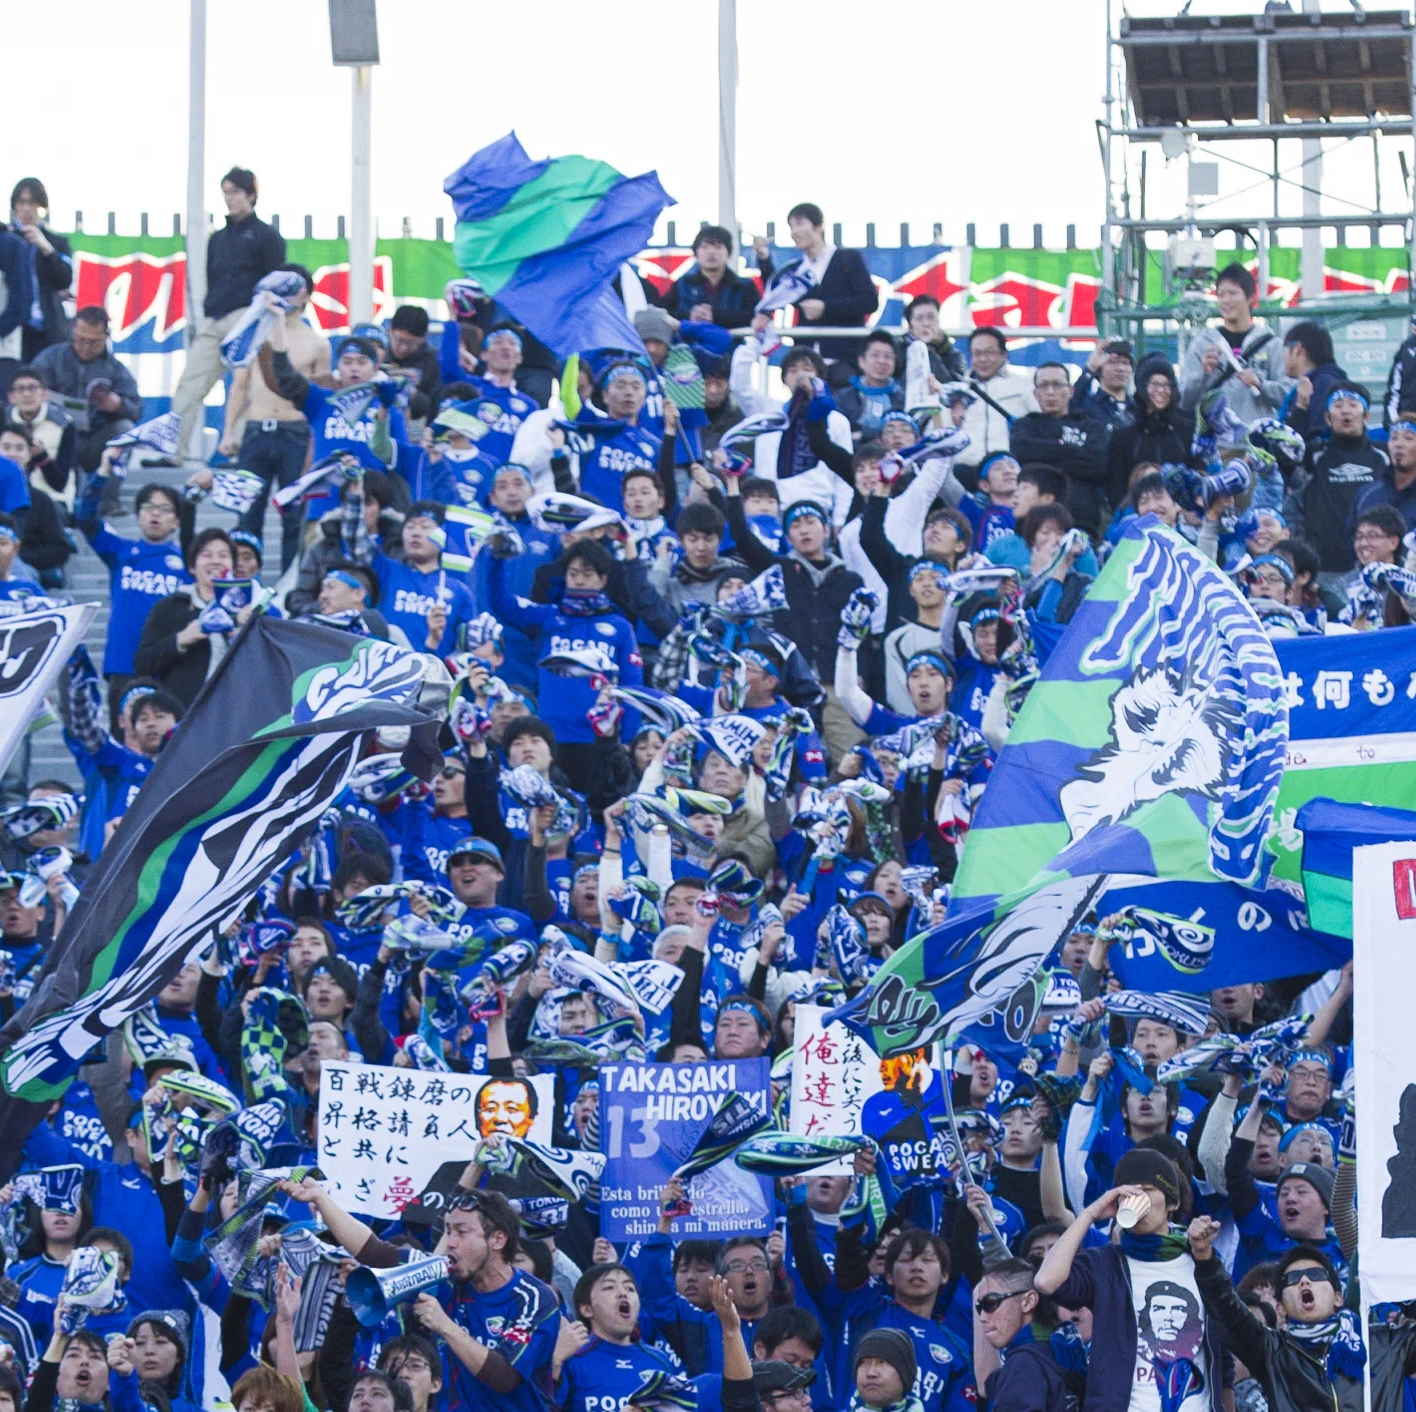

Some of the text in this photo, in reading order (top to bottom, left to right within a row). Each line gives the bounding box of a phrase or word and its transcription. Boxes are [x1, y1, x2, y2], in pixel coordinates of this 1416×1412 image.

[600, 1064, 737, 1093] TAKASAKI
[322, 1102, 481, 1142] 昇格請負人
[322, 1134, 410, 1165] と共に
[600, 1186, 633, 1203] Esta
